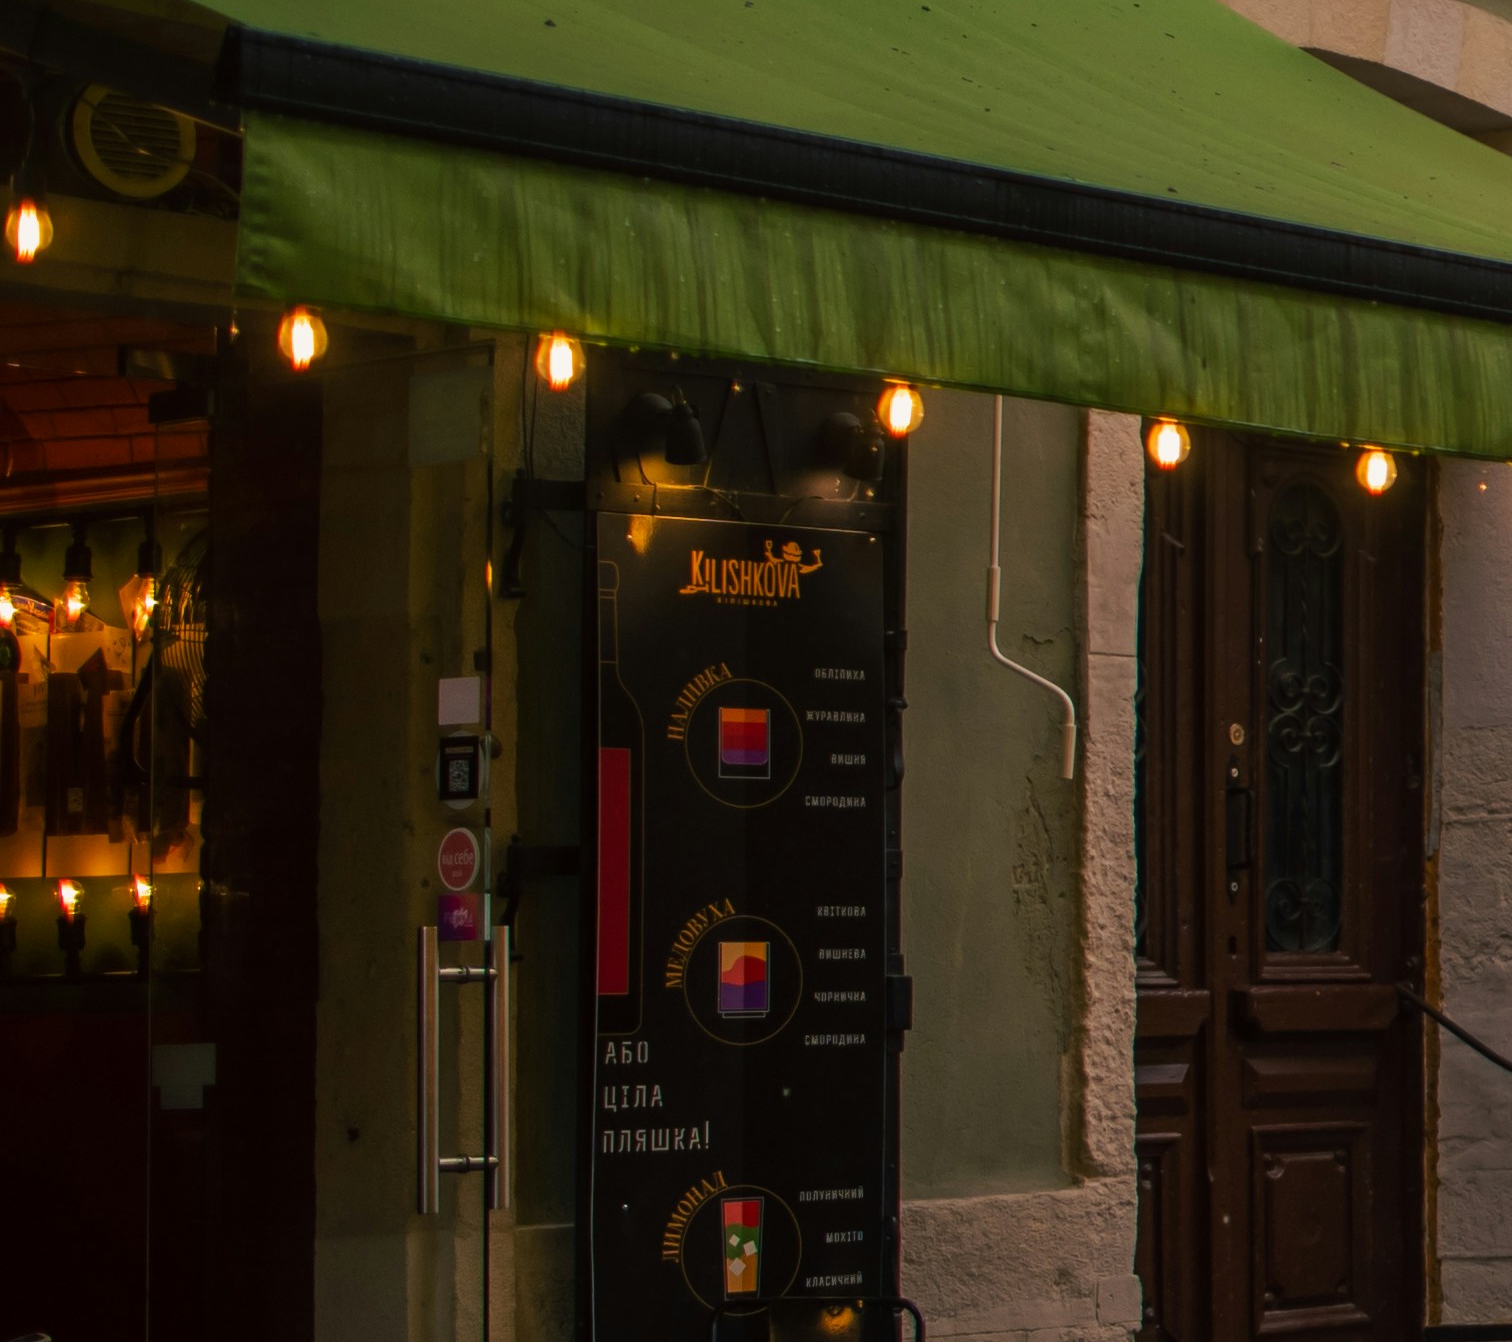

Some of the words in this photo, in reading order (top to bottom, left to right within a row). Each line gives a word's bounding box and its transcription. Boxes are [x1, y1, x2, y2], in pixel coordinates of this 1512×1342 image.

[691, 550, 800, 598] KILISHKOVA
[814, 668, 866, 681] ОБЛІПИХА
[667, 662, 733, 740] НАЛИВКА
[806, 710, 866, 722] ЖУРАВЛИНА
[805, 795, 866, 808] СМОРОДИНА
[454, 848, 473, 865] себе
[817, 906, 866, 917] КВІТКОВА
[665, 898, 735, 989] МЕДОВУХА
[819, 948, 866, 959] ВИШНЕВА
[814, 991, 866, 1003] ЧОРНИЧНА
[804, 1033, 866, 1046] СМОРОДИНА
[605, 1041, 649, 1064] АБО
[604, 1084, 663, 1112] ЦІЛА
[602, 1120, 710, 1153] ПЛЯШКА!
[799, 1185, 864, 1201] ПОЛУНИЧНИЙ
[662, 1170, 729, 1263] ЛИМОНАД
[825, 1231, 864, 1243] МОХІТО
[806, 1271, 863, 1288] КЛАСИЧНИЙ
